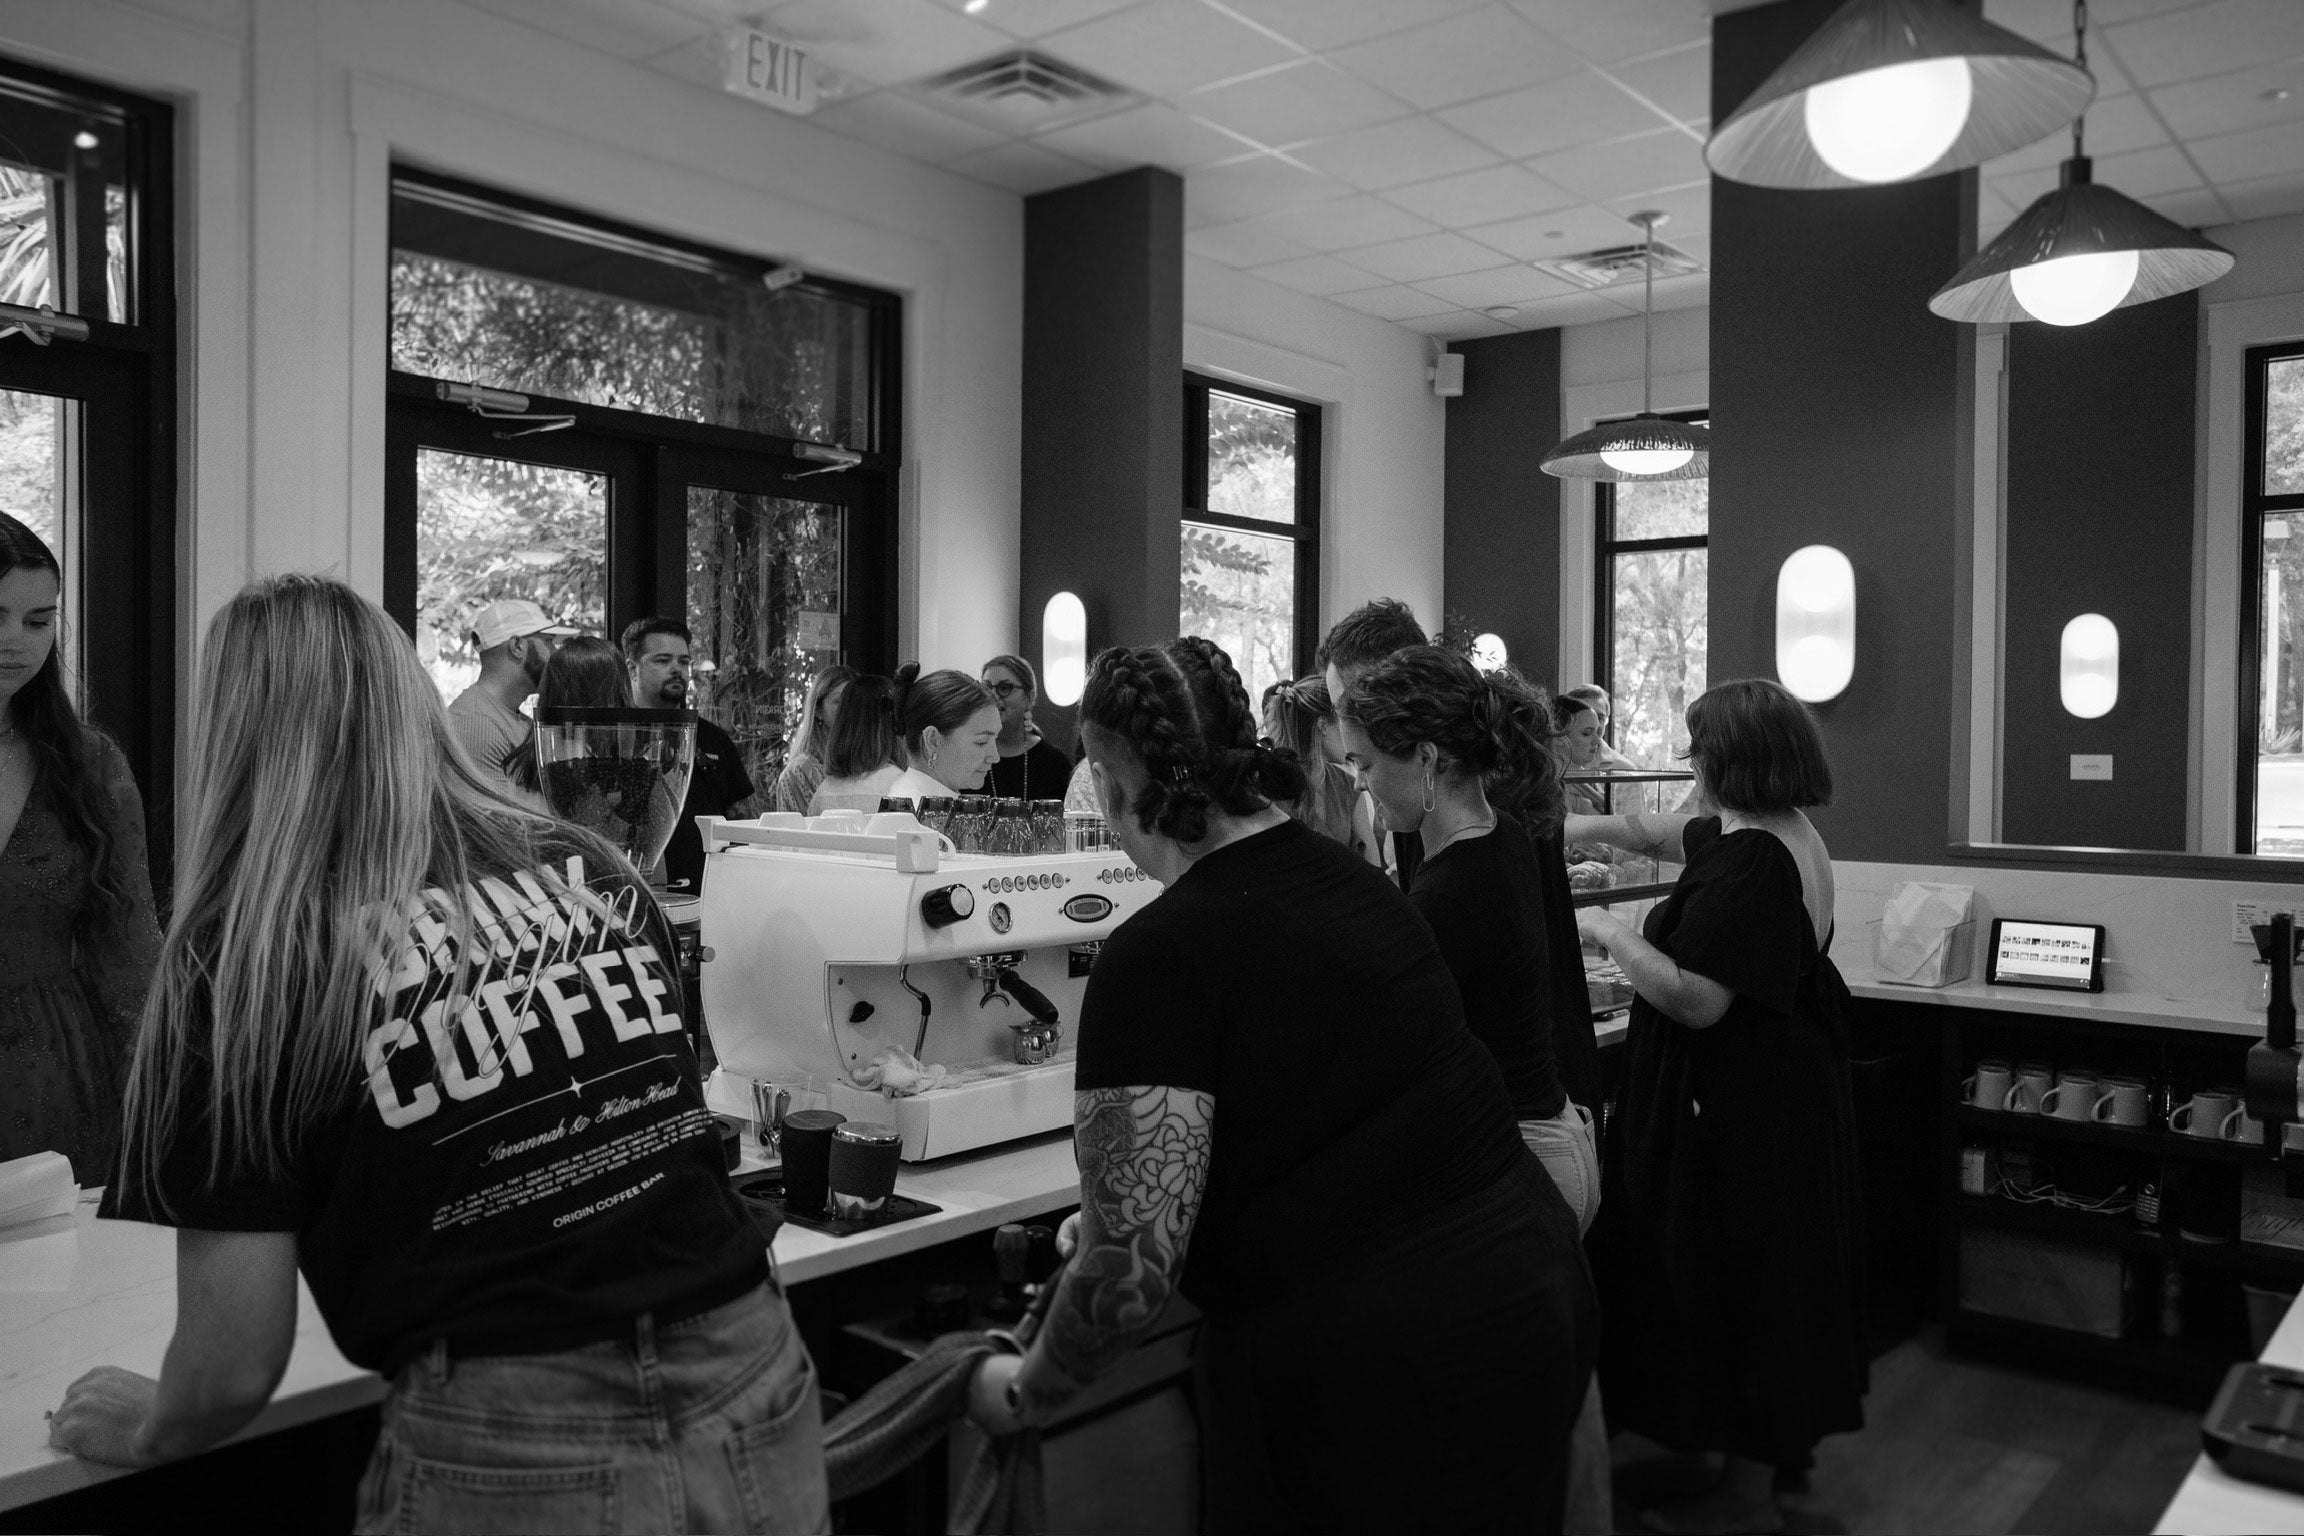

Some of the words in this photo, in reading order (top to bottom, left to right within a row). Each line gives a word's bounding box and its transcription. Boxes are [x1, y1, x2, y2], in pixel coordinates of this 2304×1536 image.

[748, 33, 806, 101] EXIT
[364, 945, 682, 1129] COFFEE
[480, 1117, 567, 1167] Savannah
[569, 1114, 591, 1135] &
[595, 1094, 642, 1123] Hilton
[642, 1076, 682, 1107] Head
[507, 1176, 522, 1185] THAT
[548, 1159, 569, 1170] COFFEE
[553, 1204, 595, 1228] ORIGIN
[596, 1186, 641, 1211] COFFEE
[641, 1172, 665, 1190] BAR
